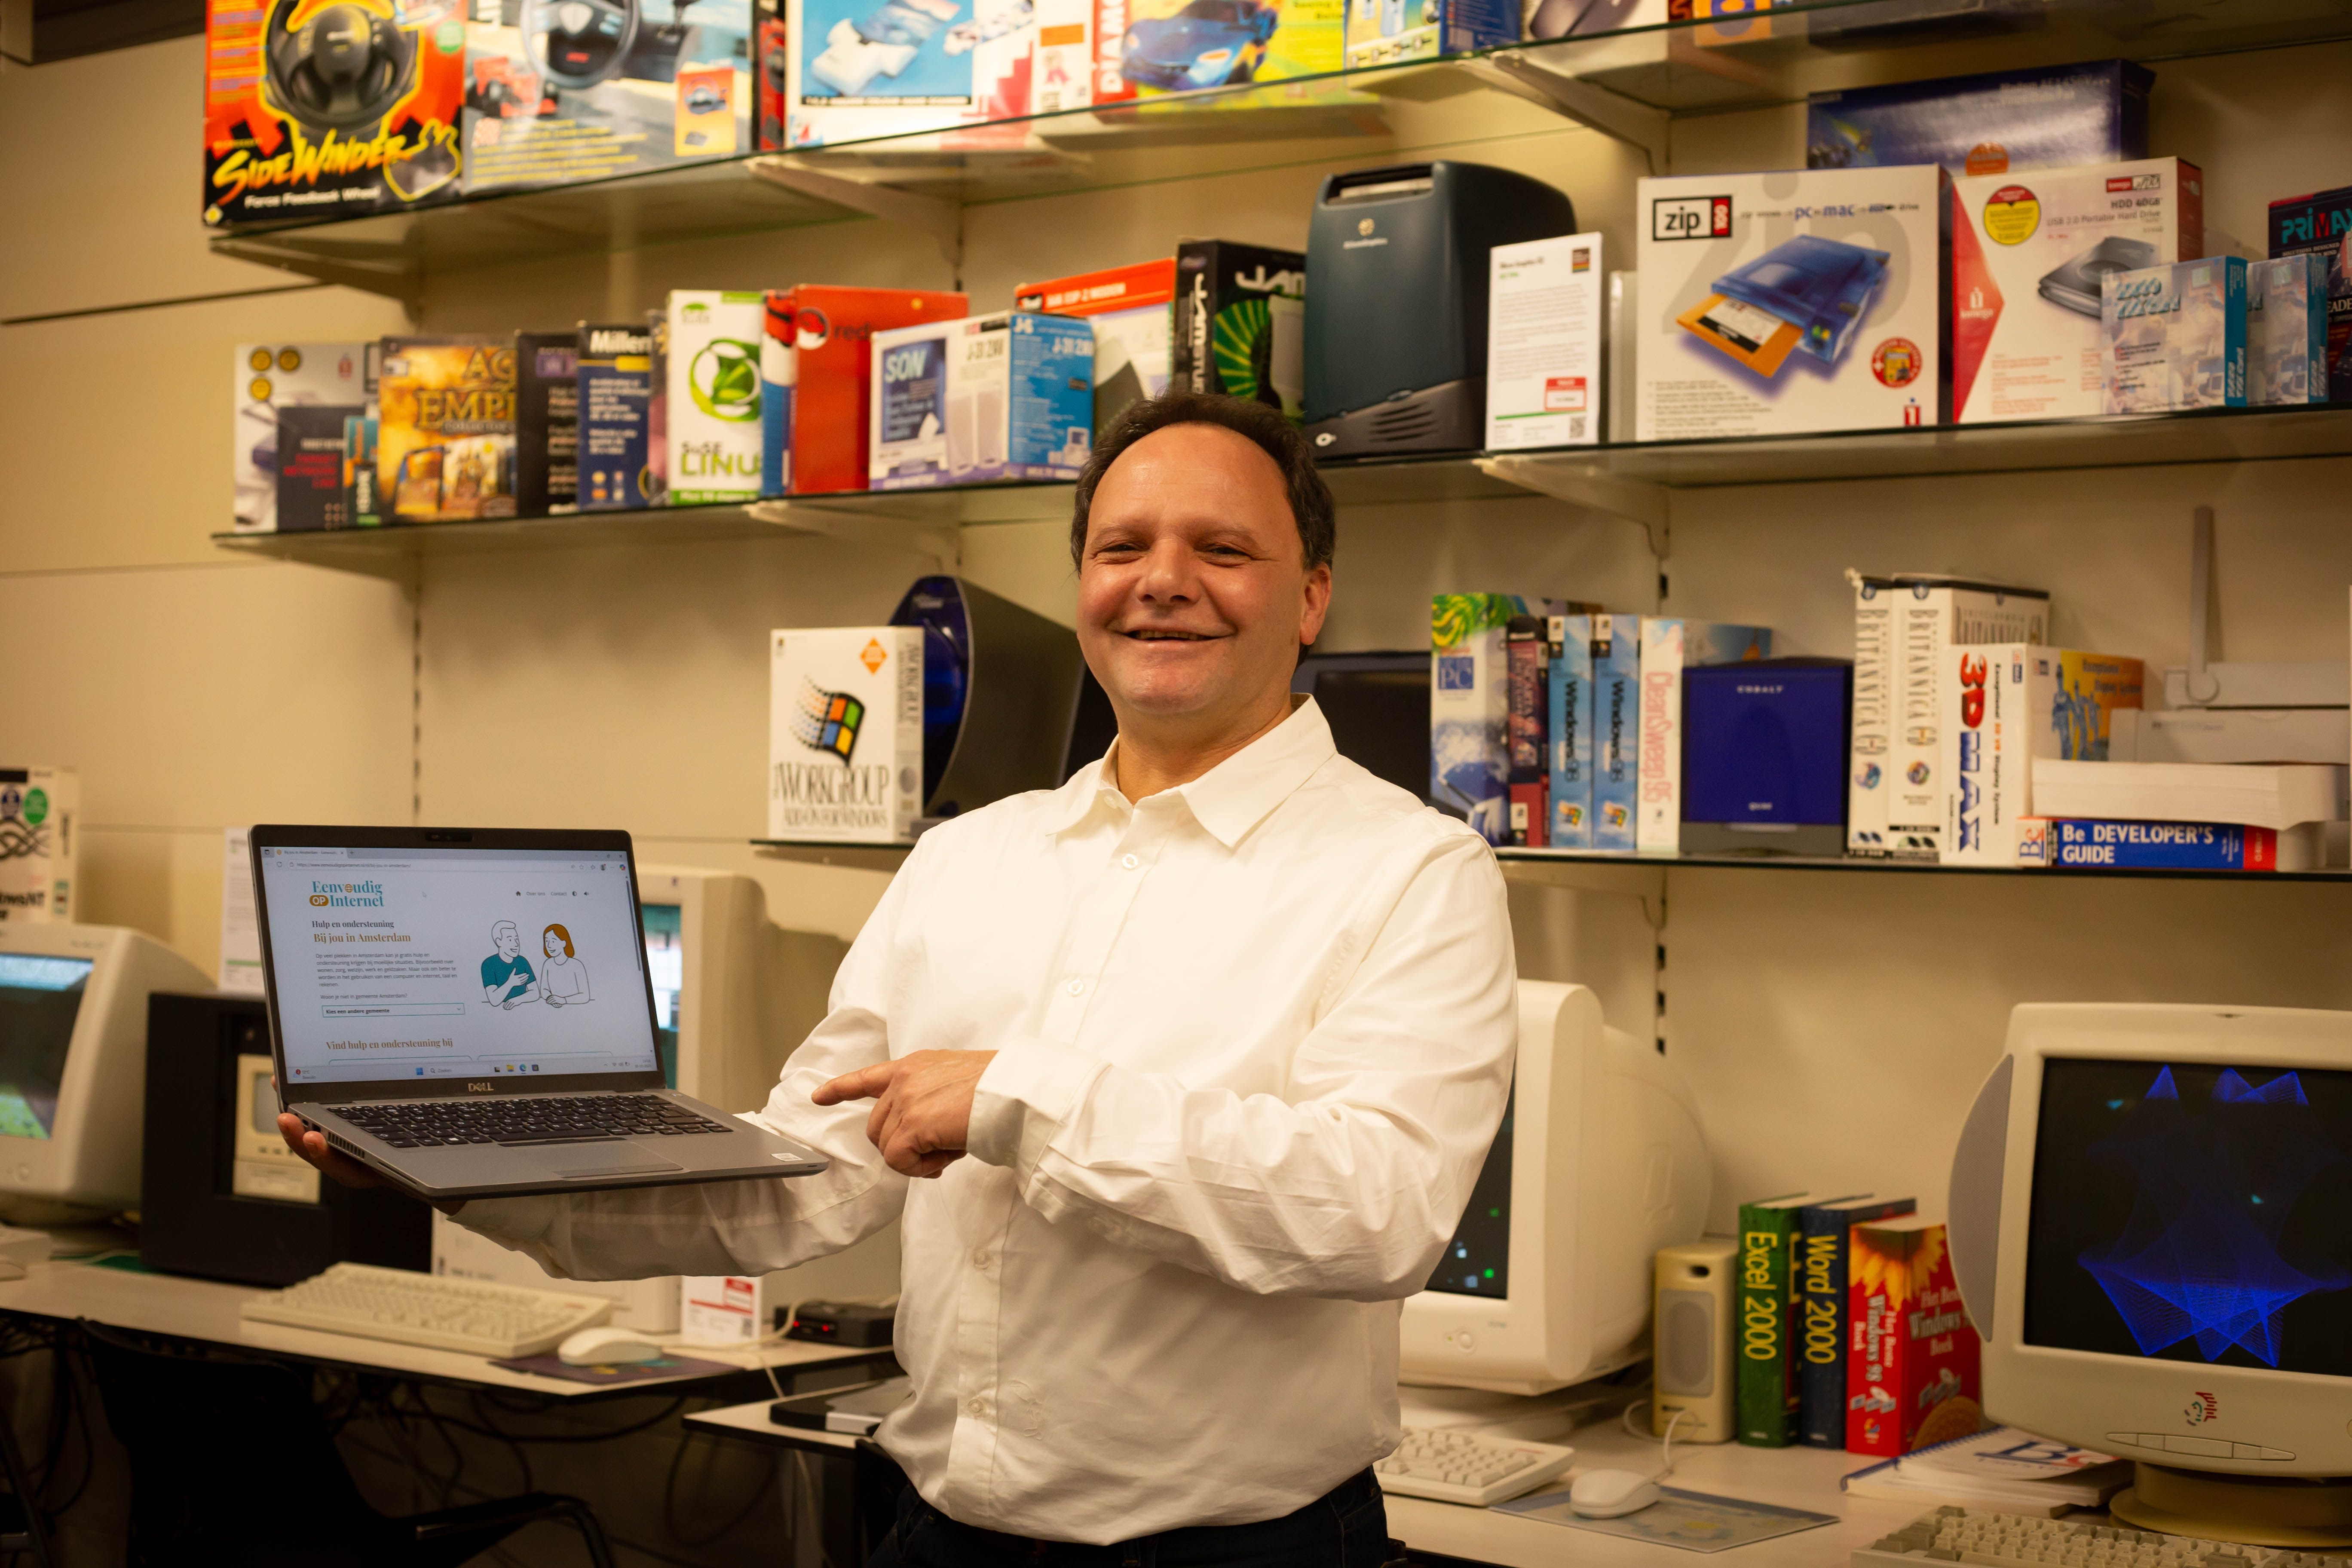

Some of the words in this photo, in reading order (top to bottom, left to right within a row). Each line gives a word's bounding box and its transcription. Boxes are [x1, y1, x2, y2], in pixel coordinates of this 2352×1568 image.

[1100, 0, 1125, 93] DIAM
[282, 189, 340, 207] Feedback
[341, 186, 381, 202] Wheel
[2111, 199, 2133, 209] HDD
[1664, 206, 1701, 238] zip
[1795, 205, 1812, 220] pc
[1823, 203, 1856, 217] mac
[2081, 214, 2116, 223] Portable
[2117, 211, 2137, 220] Hard
[2140, 210, 2161, 218] Drive
[413, 389, 516, 430] EMPI
[680, 453, 761, 476] LINU
[1855, 609, 1889, 727] BRITANNICA
[1908, 609, 1939, 720] BRITANNICA
[1736, 685, 1784, 694] COBALT
[778, 762, 891, 806] WORKGROUP
[2063, 824, 2086, 843] Be
[2093, 824, 2214, 845] DEVELOPER'S
[2062, 844, 2115, 864] GUIDE
[312, 880, 383, 896] Eenvoudig
[312, 897, 326, 905] OP
[330, 895, 385, 907] Internet
[312, 920, 330, 929] Hulp
[342, 920, 395, 929] ondersteuning
[314, 933, 327, 944] Bij
[329, 933, 343, 944] jou
[346, 933, 355, 943] in
[357, 932, 411, 943] Amsterdam
[326, 1041, 346, 1050] Vind
[348, 1040, 367, 1051] hulp
[381, 1039, 441, 1049] ondersteuning
[443, 1038, 453, 1049] bij
[468, 1082, 495, 1092] DELL
[1745, 1231, 1777, 1289] Excel
[1807, 1235, 1838, 1295] Word
[1744, 1297, 1777, 1361] 2000
[1805, 1299, 1837, 1364] 2000
[1867, 1295, 1886, 1362] Windows
[1908, 1305, 1961, 1341] Windows
[1865, 1364, 1883, 1383] 98
